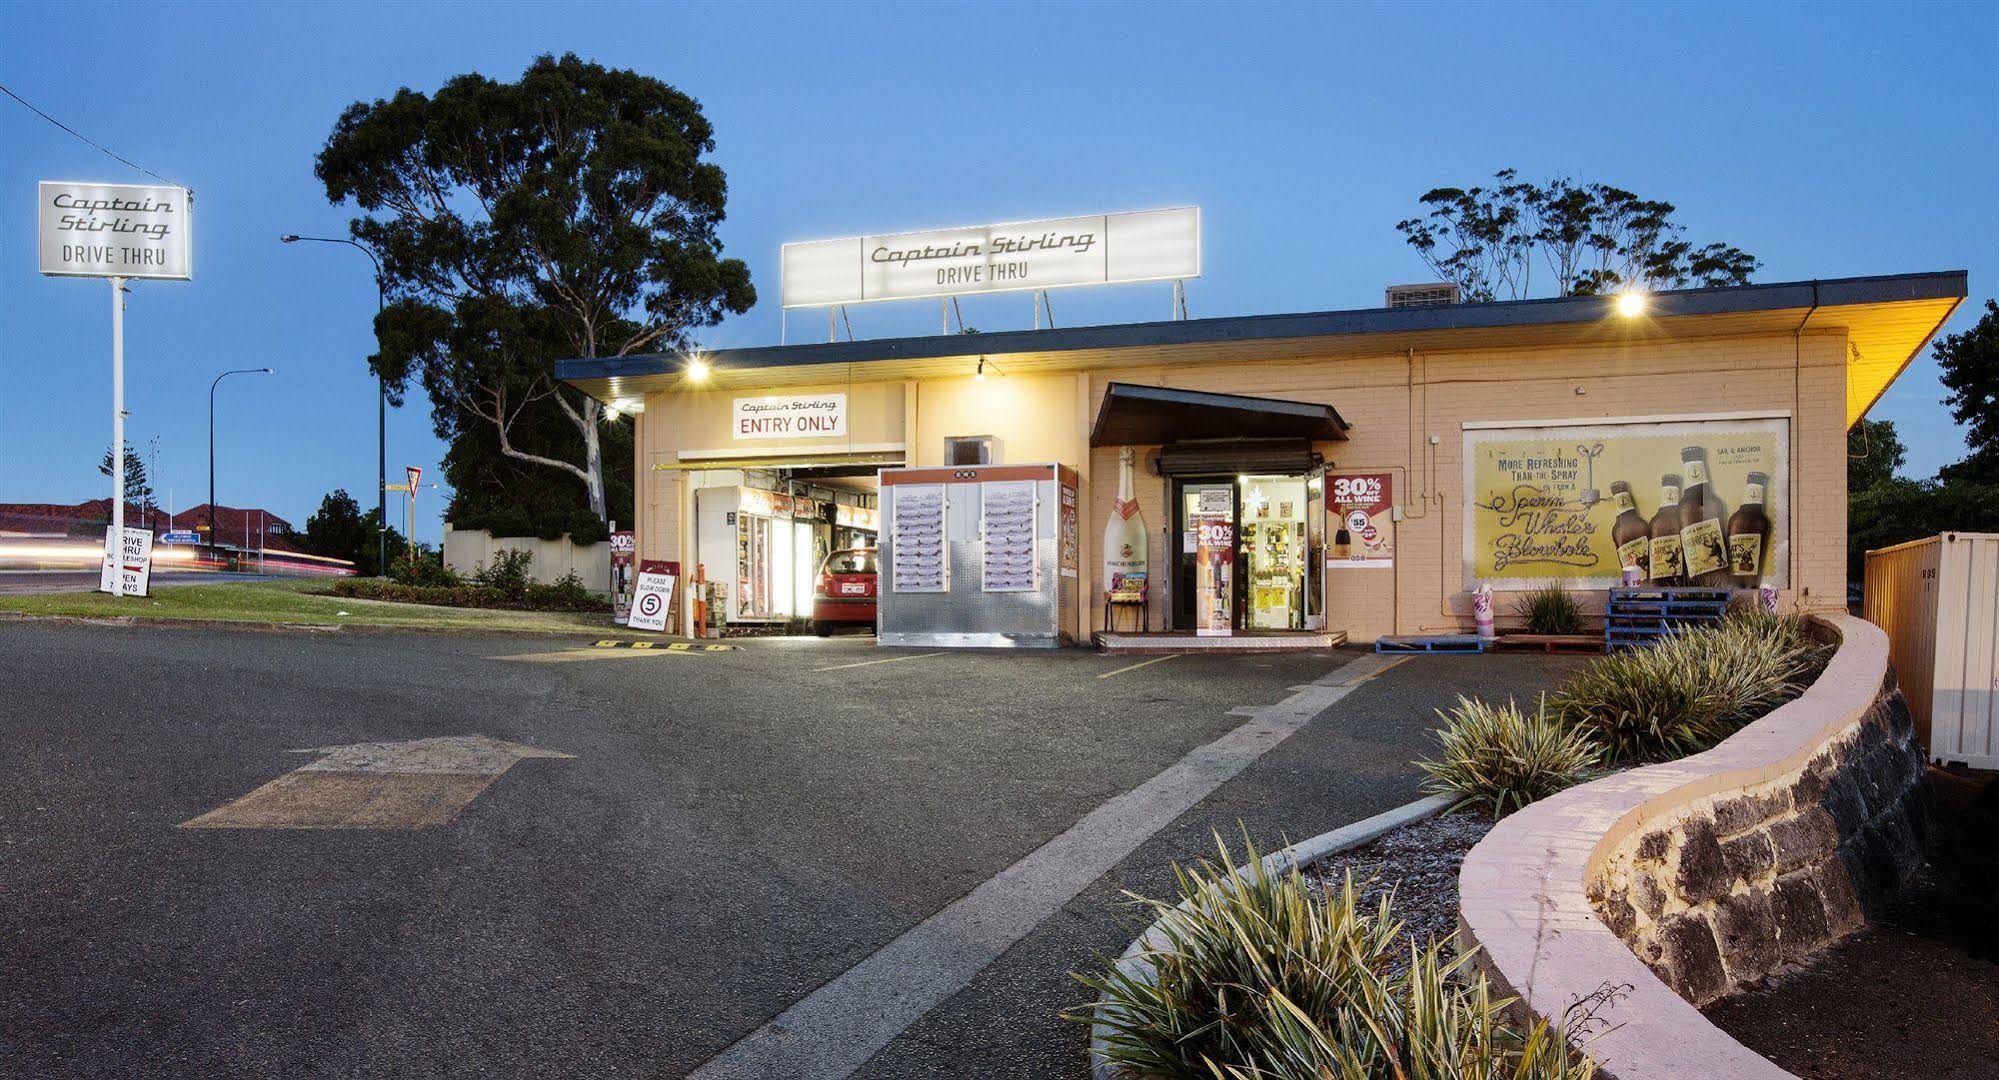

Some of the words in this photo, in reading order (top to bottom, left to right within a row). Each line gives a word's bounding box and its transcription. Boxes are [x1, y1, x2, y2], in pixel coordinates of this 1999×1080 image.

[53, 193, 174, 216] Captain
[57, 215, 171, 240] Stirling
[63, 245, 114, 263] DRIVE
[121, 247, 165, 265] THRU
[871, 241, 982, 268] Captain
[988, 232, 1097, 258] Stirling
[936, 265, 983, 285] DRIVE
[988, 261, 1029, 282] THRU
[741, 403, 790, 413] Captain
[791, 400, 837, 412] Stirling
[741, 417, 792, 433] ENTRY
[797, 415, 838, 431] ONLY
[1498, 459, 1523, 471] MORE
[1527, 457, 1578, 470] REFRESHING
[1511, 472, 1533, 482] THAN
[1551, 470, 1578, 481] SPRAY
[1334, 478, 1381, 496] 30%
[1198, 525, 1232, 540] 30%
[123, 536, 143, 547] RIVE
[610, 535, 635, 547] 30%
[123, 546, 141, 555] HRU
[647, 576, 666, 585] PLEASE
[123, 584, 138, 592] AYS
[645, 598, 656, 611] 5
[633, 616, 652, 624] THANK
